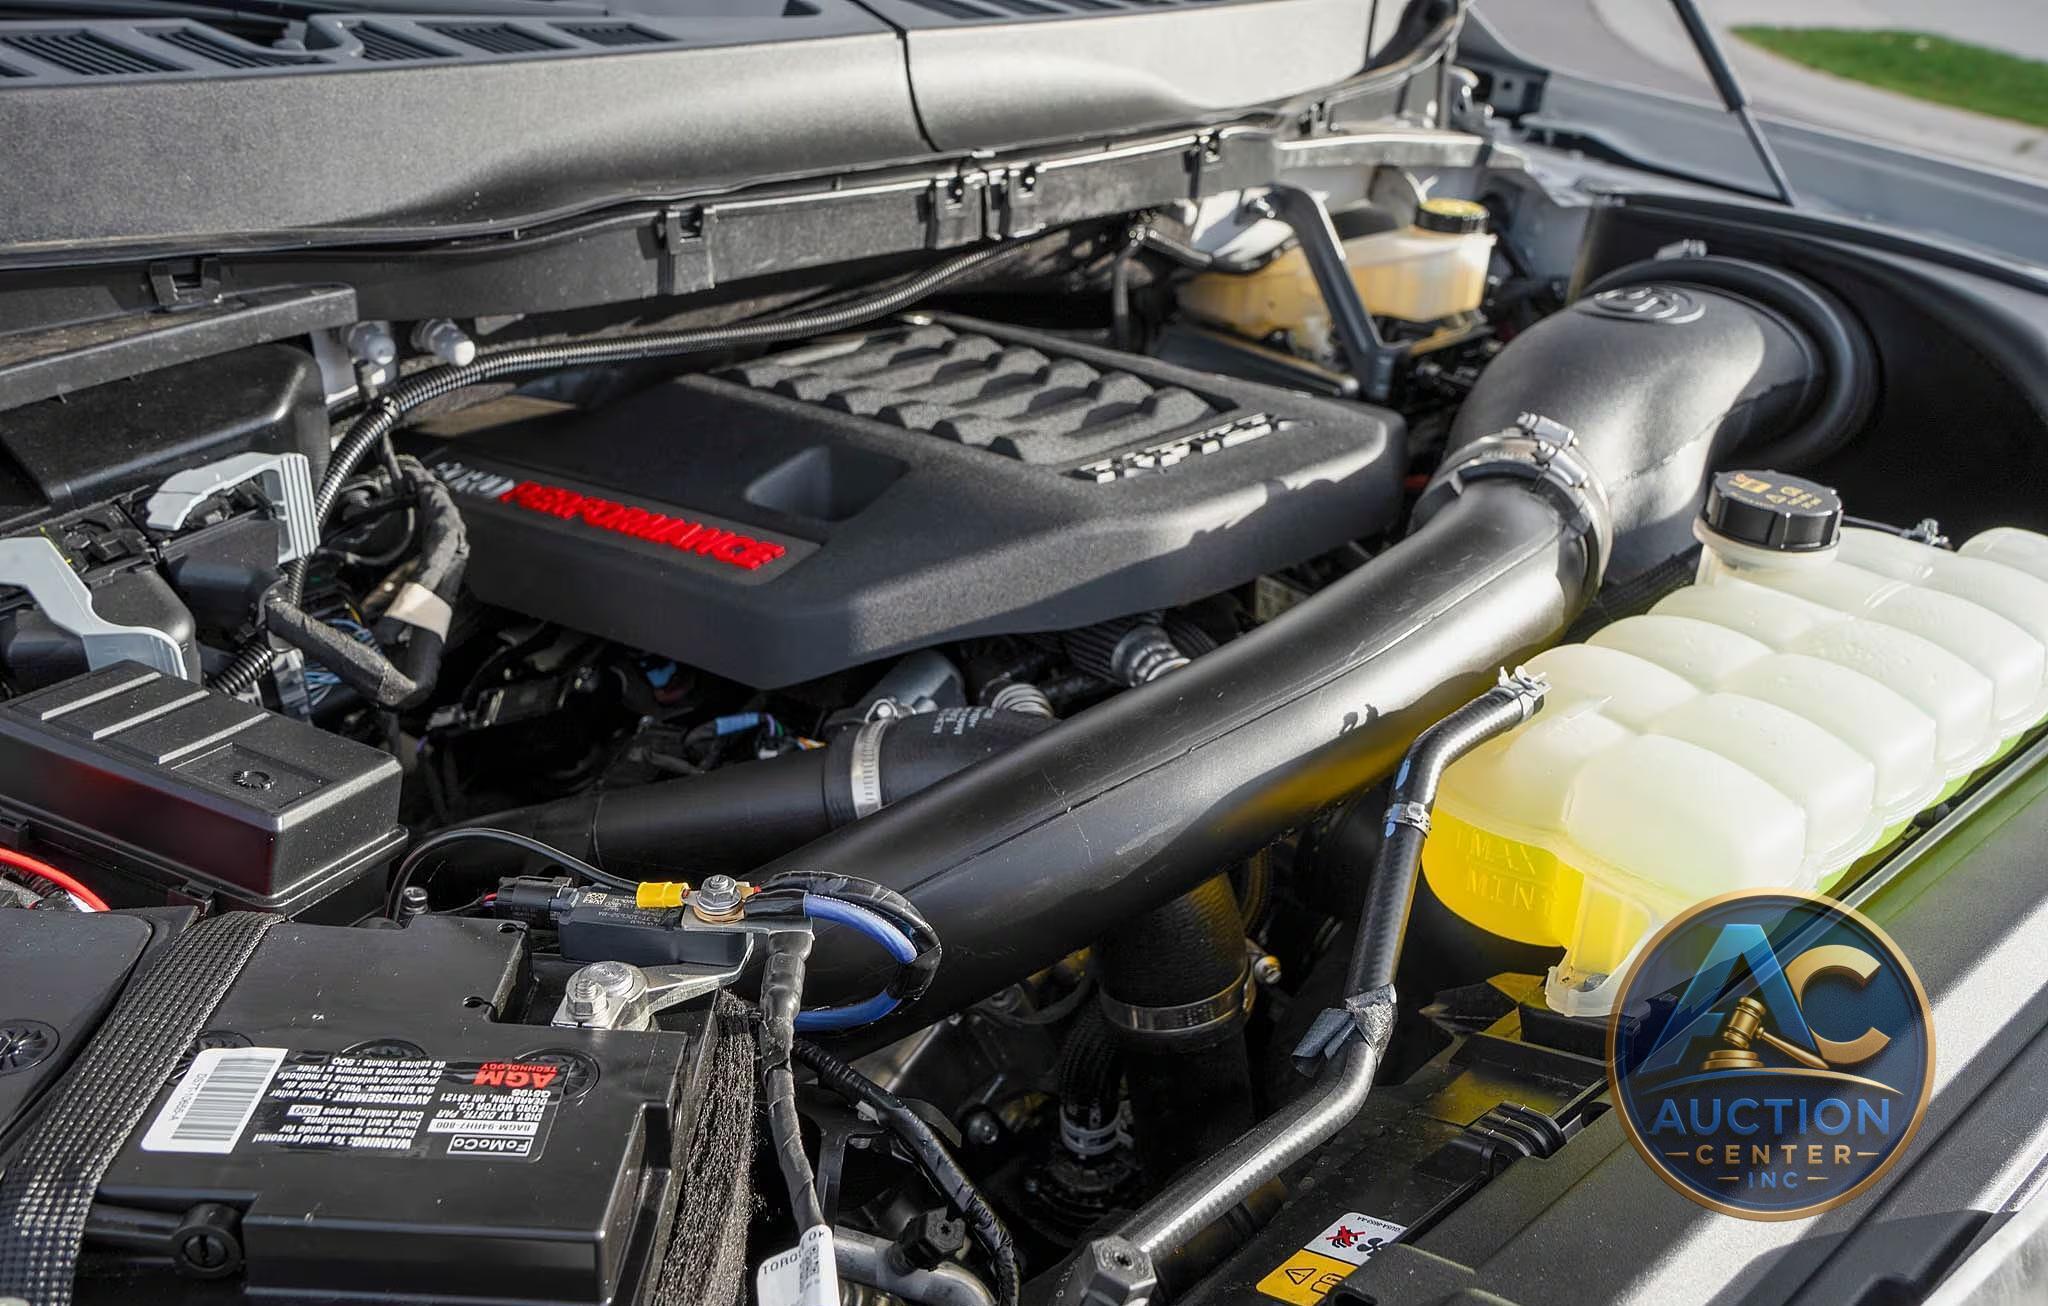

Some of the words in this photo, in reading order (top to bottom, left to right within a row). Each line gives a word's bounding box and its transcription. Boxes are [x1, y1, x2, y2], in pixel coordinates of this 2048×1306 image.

[500, 481, 785, 570] PERFORMANCE
[363, 1059, 398, 1068] volants
[433, 1061, 446, 1069] de
[480, 1064, 558, 1072] TECHNOLOGY
[336, 1066, 373, 1074] secours
[473, 1070, 556, 1088] AGM
[283, 1081, 298, 1090] du
[300, 1081, 328, 1090] guide
[341, 1084, 362, 1092] Voir
[365, 1085, 415, 1094] blessures.
[417, 1086, 435, 1094] des
[300, 1090, 325, 1099] Pour
[332, 1092, 432, 1105] AVERTISSEMENT
[440, 1093, 471, 1102] 48121
[472, 1094, 486, 1102] MI
[489, 1094, 548, 1104] DEARBORN,
[457, 1102, 474, 1110] CO.
[476, 1103, 515, 1111] MOTOR
[517, 1104, 545, 1112] FORD
[323, 1107, 353, 1115] amps
[354, 1107, 399, 1118] cranking
[401, 1111, 424, 1120] Cold
[436, 1109, 459, 1118] PAR
[499, 1112, 513, 1120] BY
[516, 1112, 542, 1121] DIST.
[302, 1117, 366, 1126] instructions.
[280, 1125, 298, 1133] for
[300, 1125, 328, 1133] guide
[330, 1126, 362, 1134] owner
[386, 1128, 416, 1138] injury
[253, 1133, 302, 1142] personal
[303, 1135, 332, 1145] avoid
[333, 1137, 346, 1145] To
[349, 1137, 411, 1149] WARNING:
[454, 1138, 529, 1152] FoMoCo
